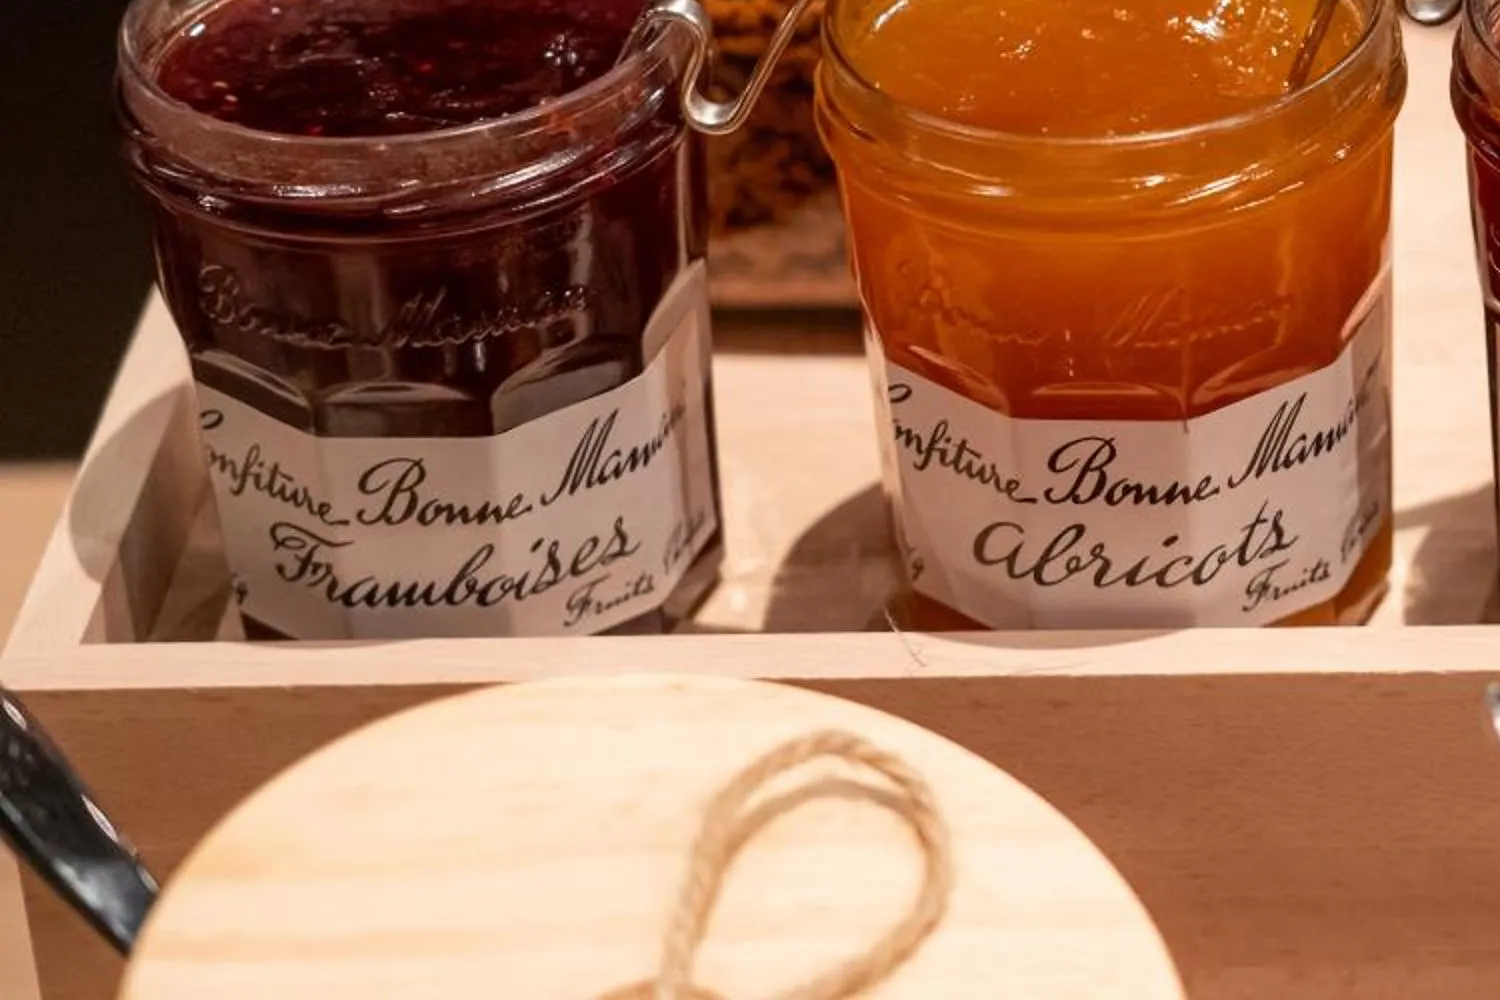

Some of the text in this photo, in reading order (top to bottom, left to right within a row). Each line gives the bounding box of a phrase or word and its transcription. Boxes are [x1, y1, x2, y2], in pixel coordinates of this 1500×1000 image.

[356, 457, 532, 526] Bonne
[1043, 436, 1220, 506] Bonne
[269, 515, 641, 607] Framboises
